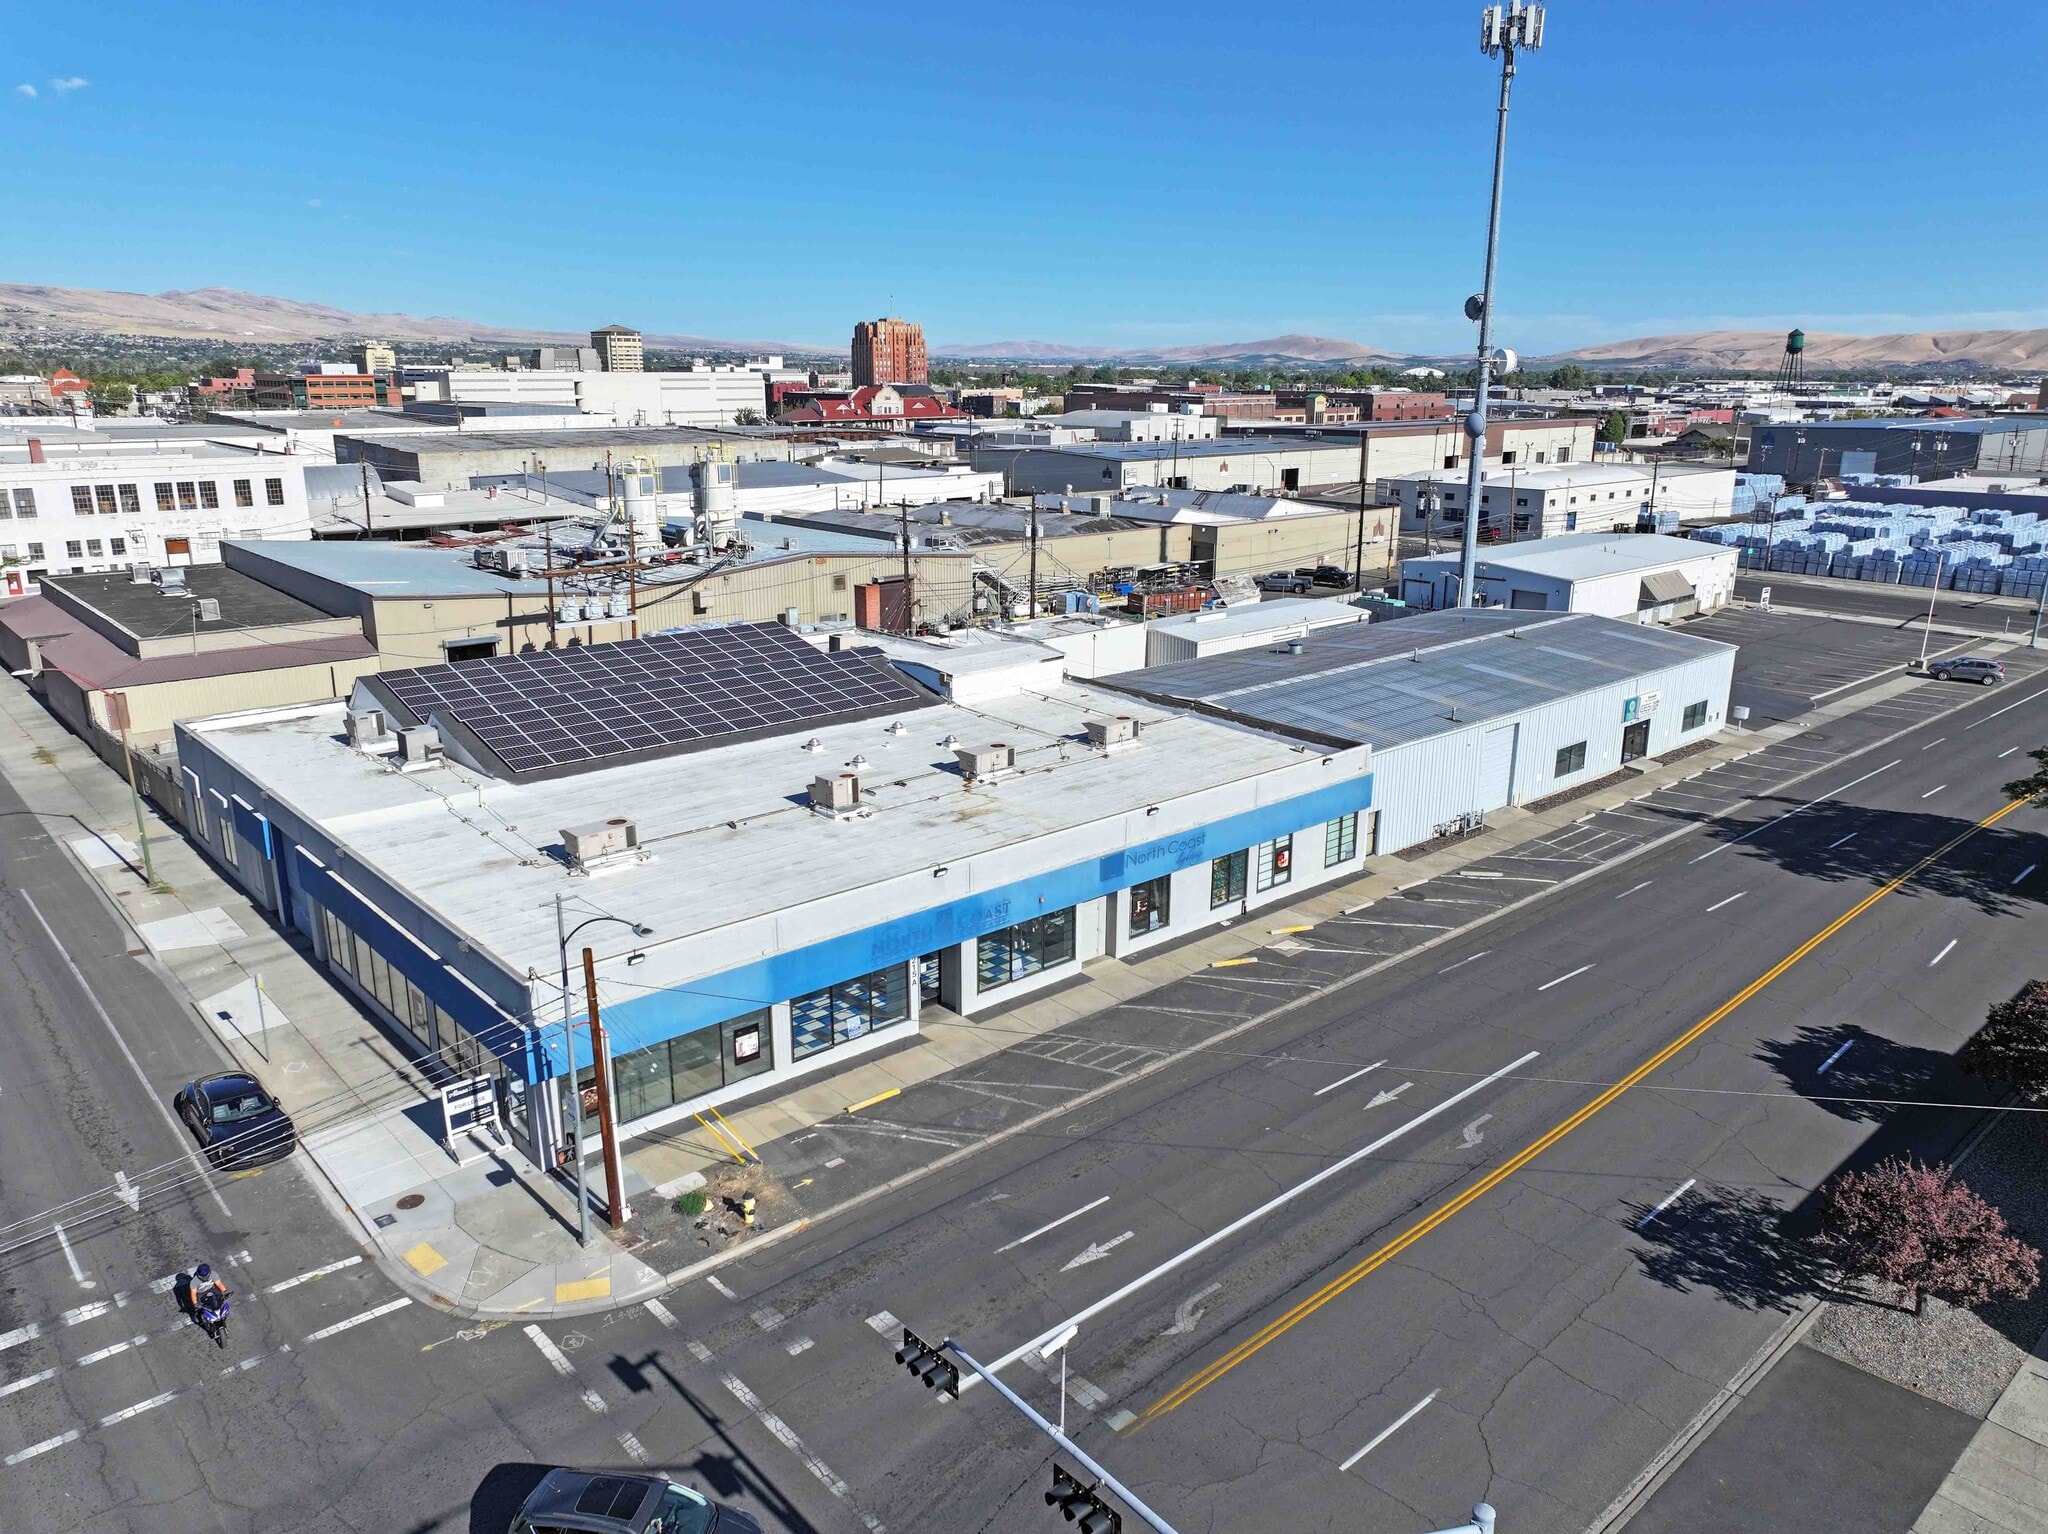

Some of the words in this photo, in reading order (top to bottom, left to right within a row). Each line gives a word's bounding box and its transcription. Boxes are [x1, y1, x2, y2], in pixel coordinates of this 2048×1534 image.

[1125, 846, 1165, 869] North
[1167, 832, 1206, 854] Coast
[454, 1101, 467, 1110] FOR
